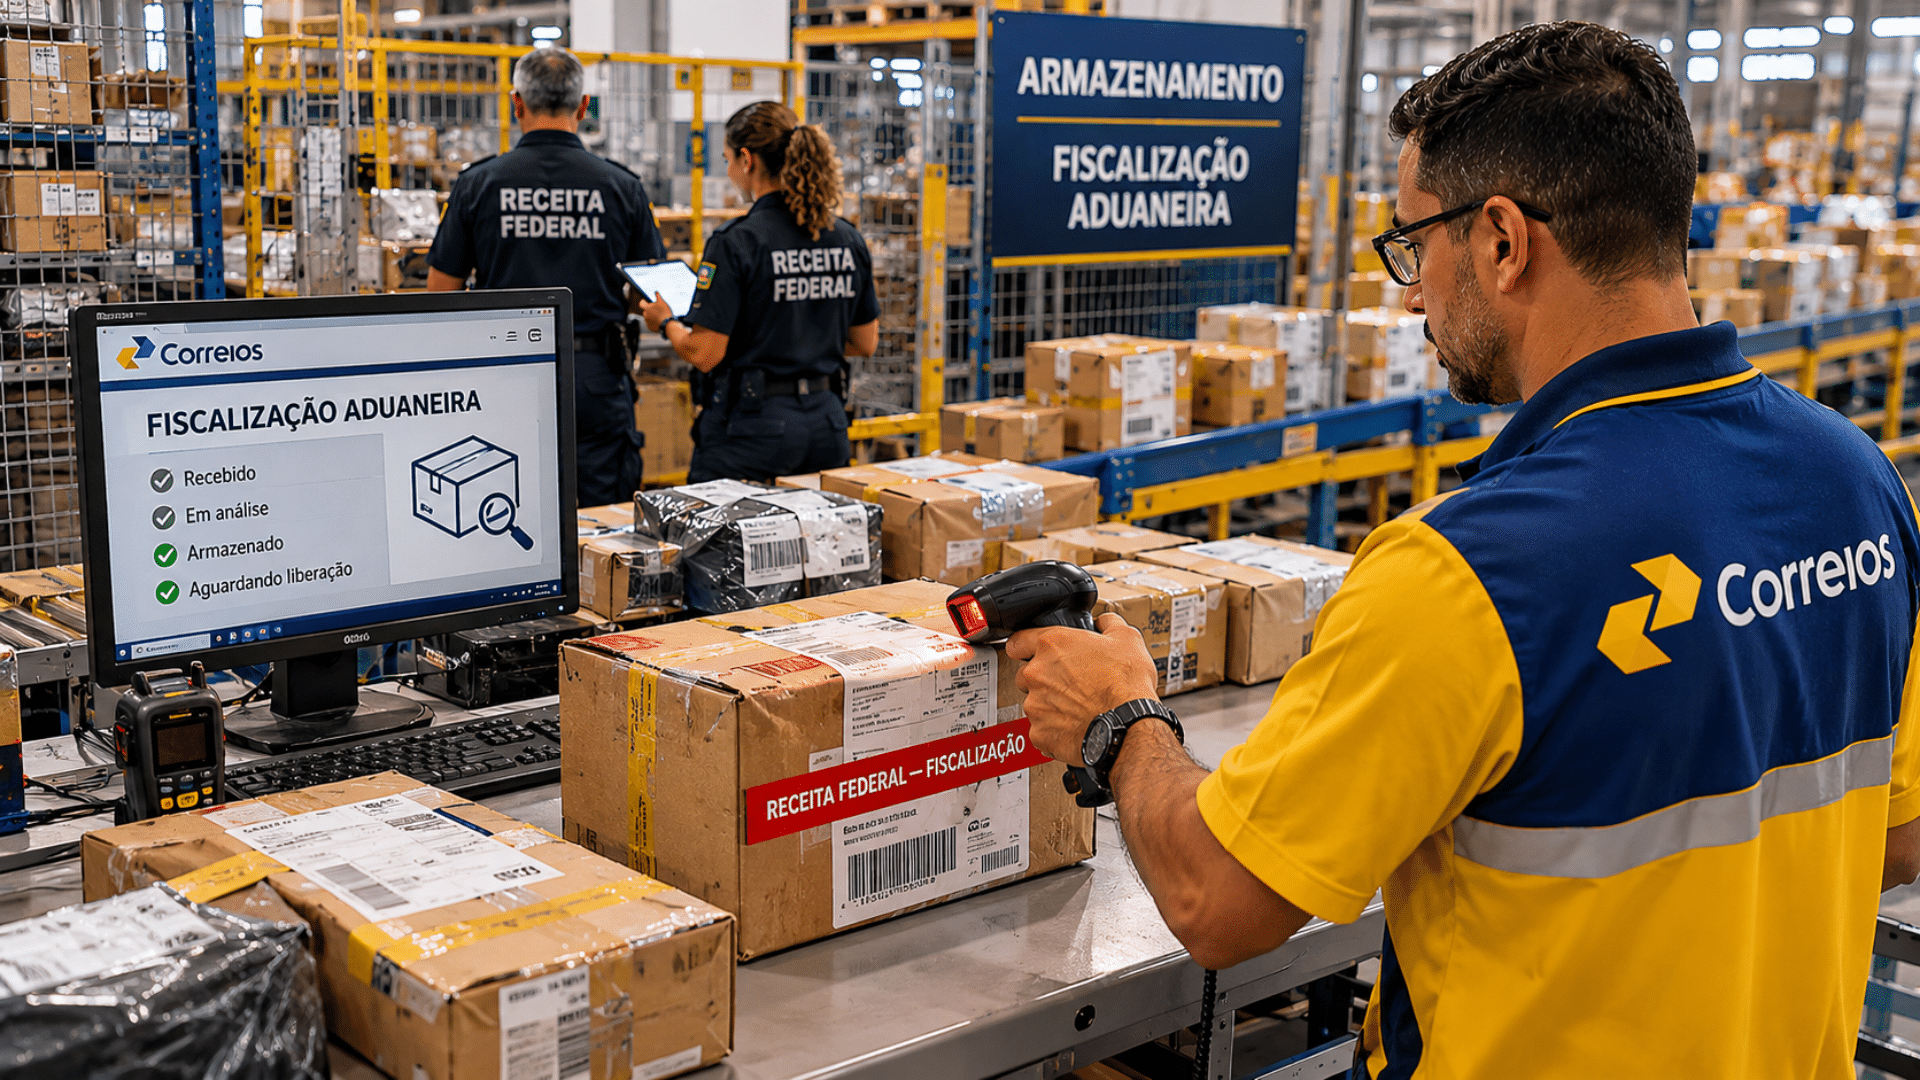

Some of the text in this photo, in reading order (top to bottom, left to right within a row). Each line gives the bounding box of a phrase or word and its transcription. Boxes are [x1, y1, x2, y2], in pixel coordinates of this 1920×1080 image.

[1017, 57, 1284, 103] ARMAZENAMENTO
[1053, 137, 1250, 188] FISCALIZAÇÃO
[500, 188, 605, 213] RECEITA
[1068, 191, 1231, 229] ADUANEIRA
[501, 215, 605, 239] FEDERAL
[772, 247, 856, 275] RECEITA
[774, 275, 855, 302] FEDERAL
[160, 342, 263, 366] Correios
[147, 390, 482, 438] FISCALIZAÇÃO ADUANEIRA
[184, 466, 256, 487] Recebido
[187, 502, 269, 525] Em análise
[187, 536, 284, 562] Armazenado
[189, 562, 353, 600] Aguardando liberação
[1717, 534, 1896, 627] Correios
[767, 784, 835, 821] RECEITA
[839, 767, 906, 802] FEDERAL
[926, 734, 1026, 777] FISCALIZAÇÃO
